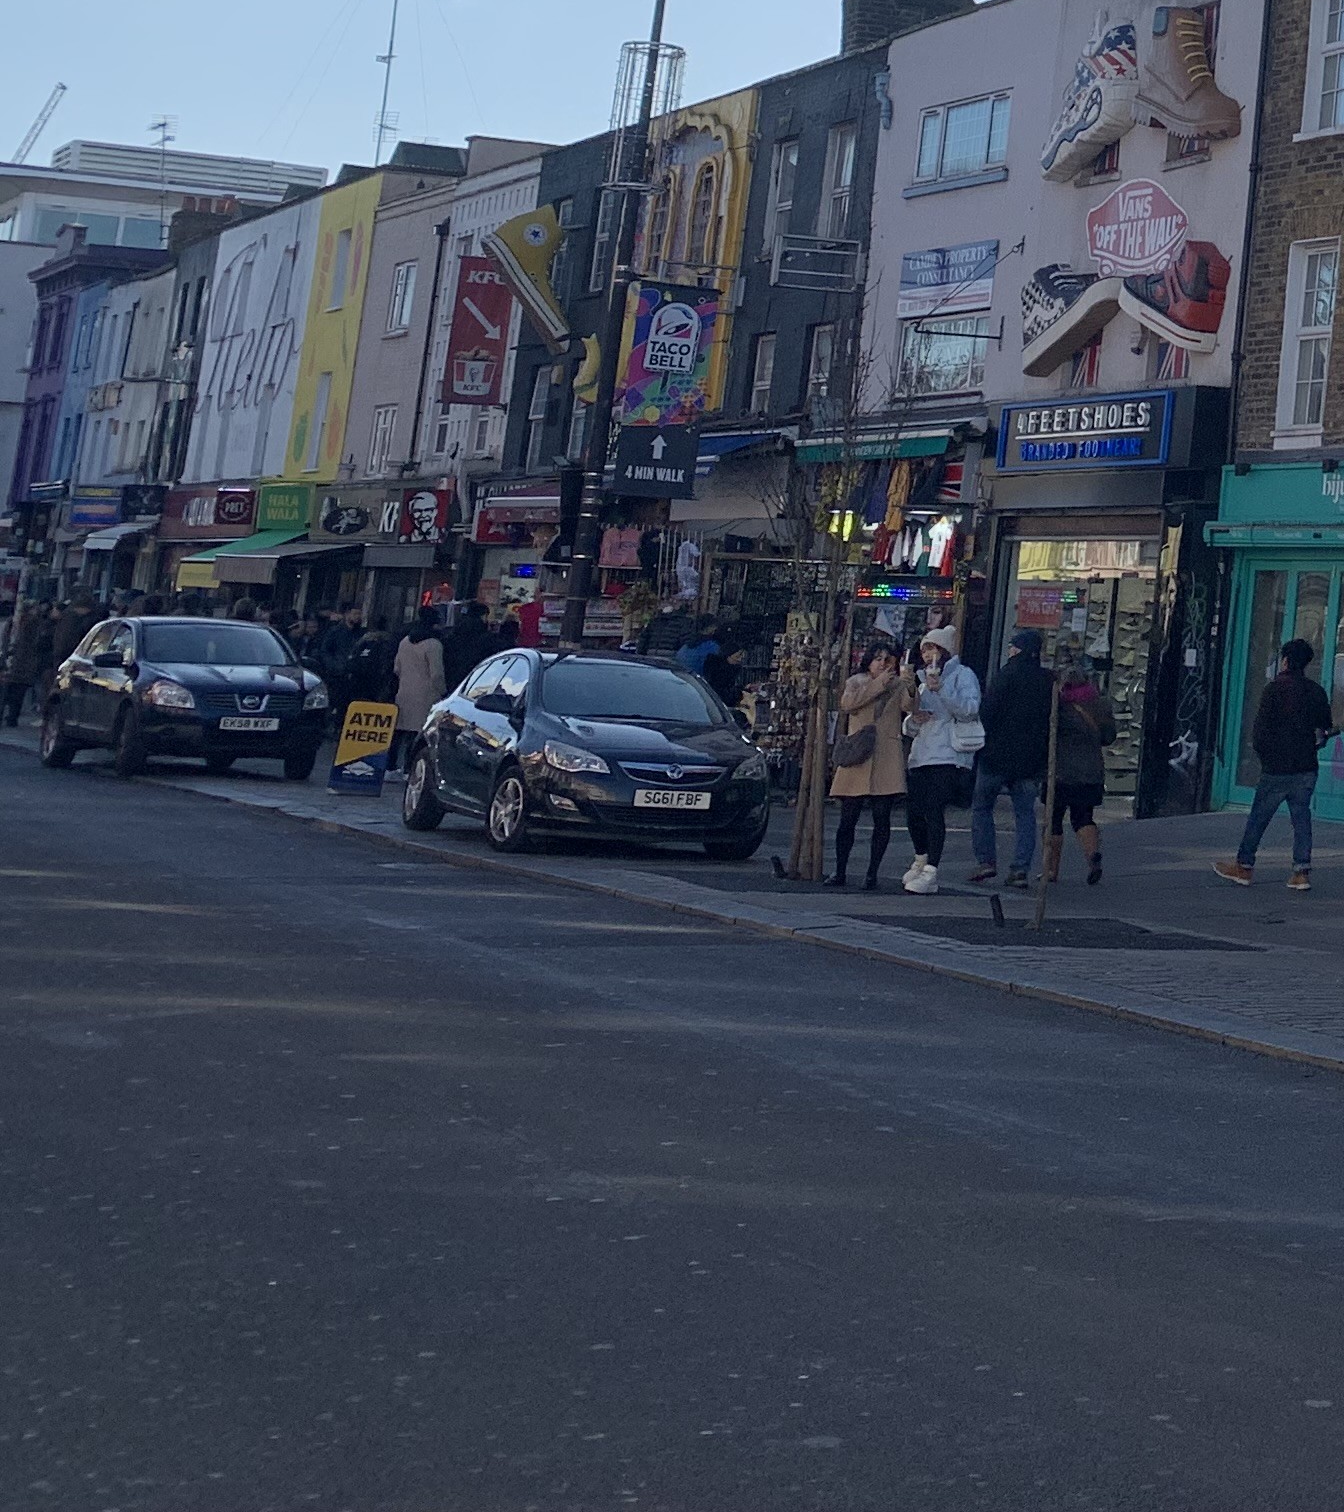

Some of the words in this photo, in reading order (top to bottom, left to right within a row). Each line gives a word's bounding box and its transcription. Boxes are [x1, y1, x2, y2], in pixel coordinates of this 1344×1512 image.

[1119, 188, 1153, 221] VANS
[1120, 220, 1144, 258] THE
[944, 246, 988, 265] PROPERTY
[917, 265, 975, 285] CONSULTANCY
[650, 341, 690, 356] TACO
[649, 354, 686, 369] BELL
[625, 466, 632, 479] 4
[634, 466, 655, 480] MIN
[656, 468, 684, 483] WALK
[267, 508, 299, 520] WALA
[350, 711, 393, 729] ATM
[345, 729, 388, 744] HERE
[644, 791, 674, 806] SG61
[676, 792, 704, 807] FBF
